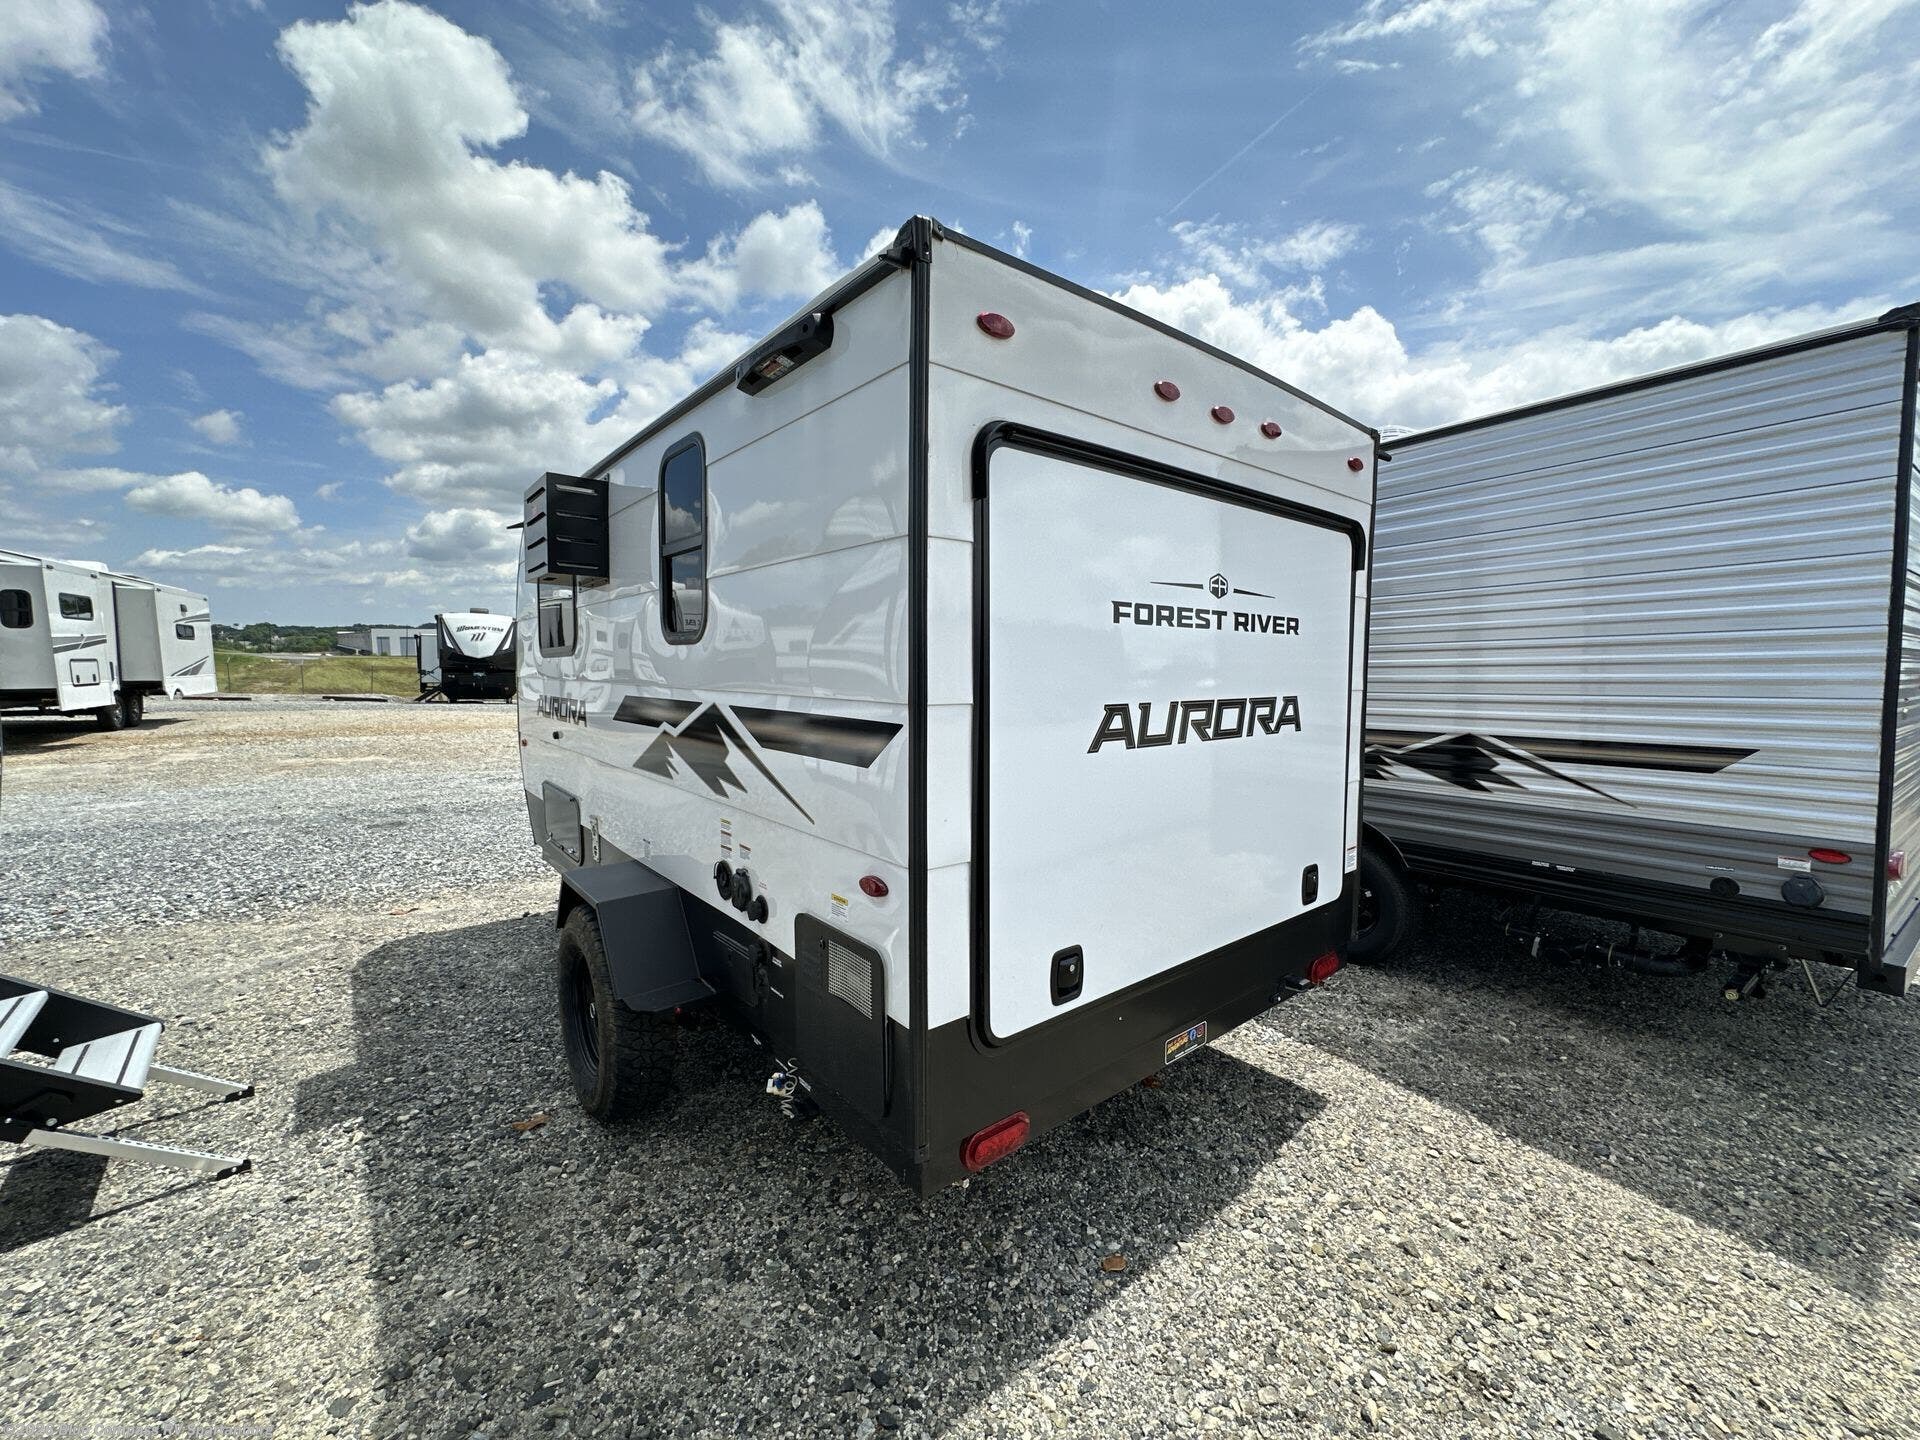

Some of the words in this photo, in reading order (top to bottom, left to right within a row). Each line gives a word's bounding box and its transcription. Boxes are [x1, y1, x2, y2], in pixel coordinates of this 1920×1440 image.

[1111, 600, 1227, 630] FOREST
[1233, 611, 1299, 635] RIVER
[536, 695, 588, 728] AURORA
[1087, 695, 1301, 754] AURORA
